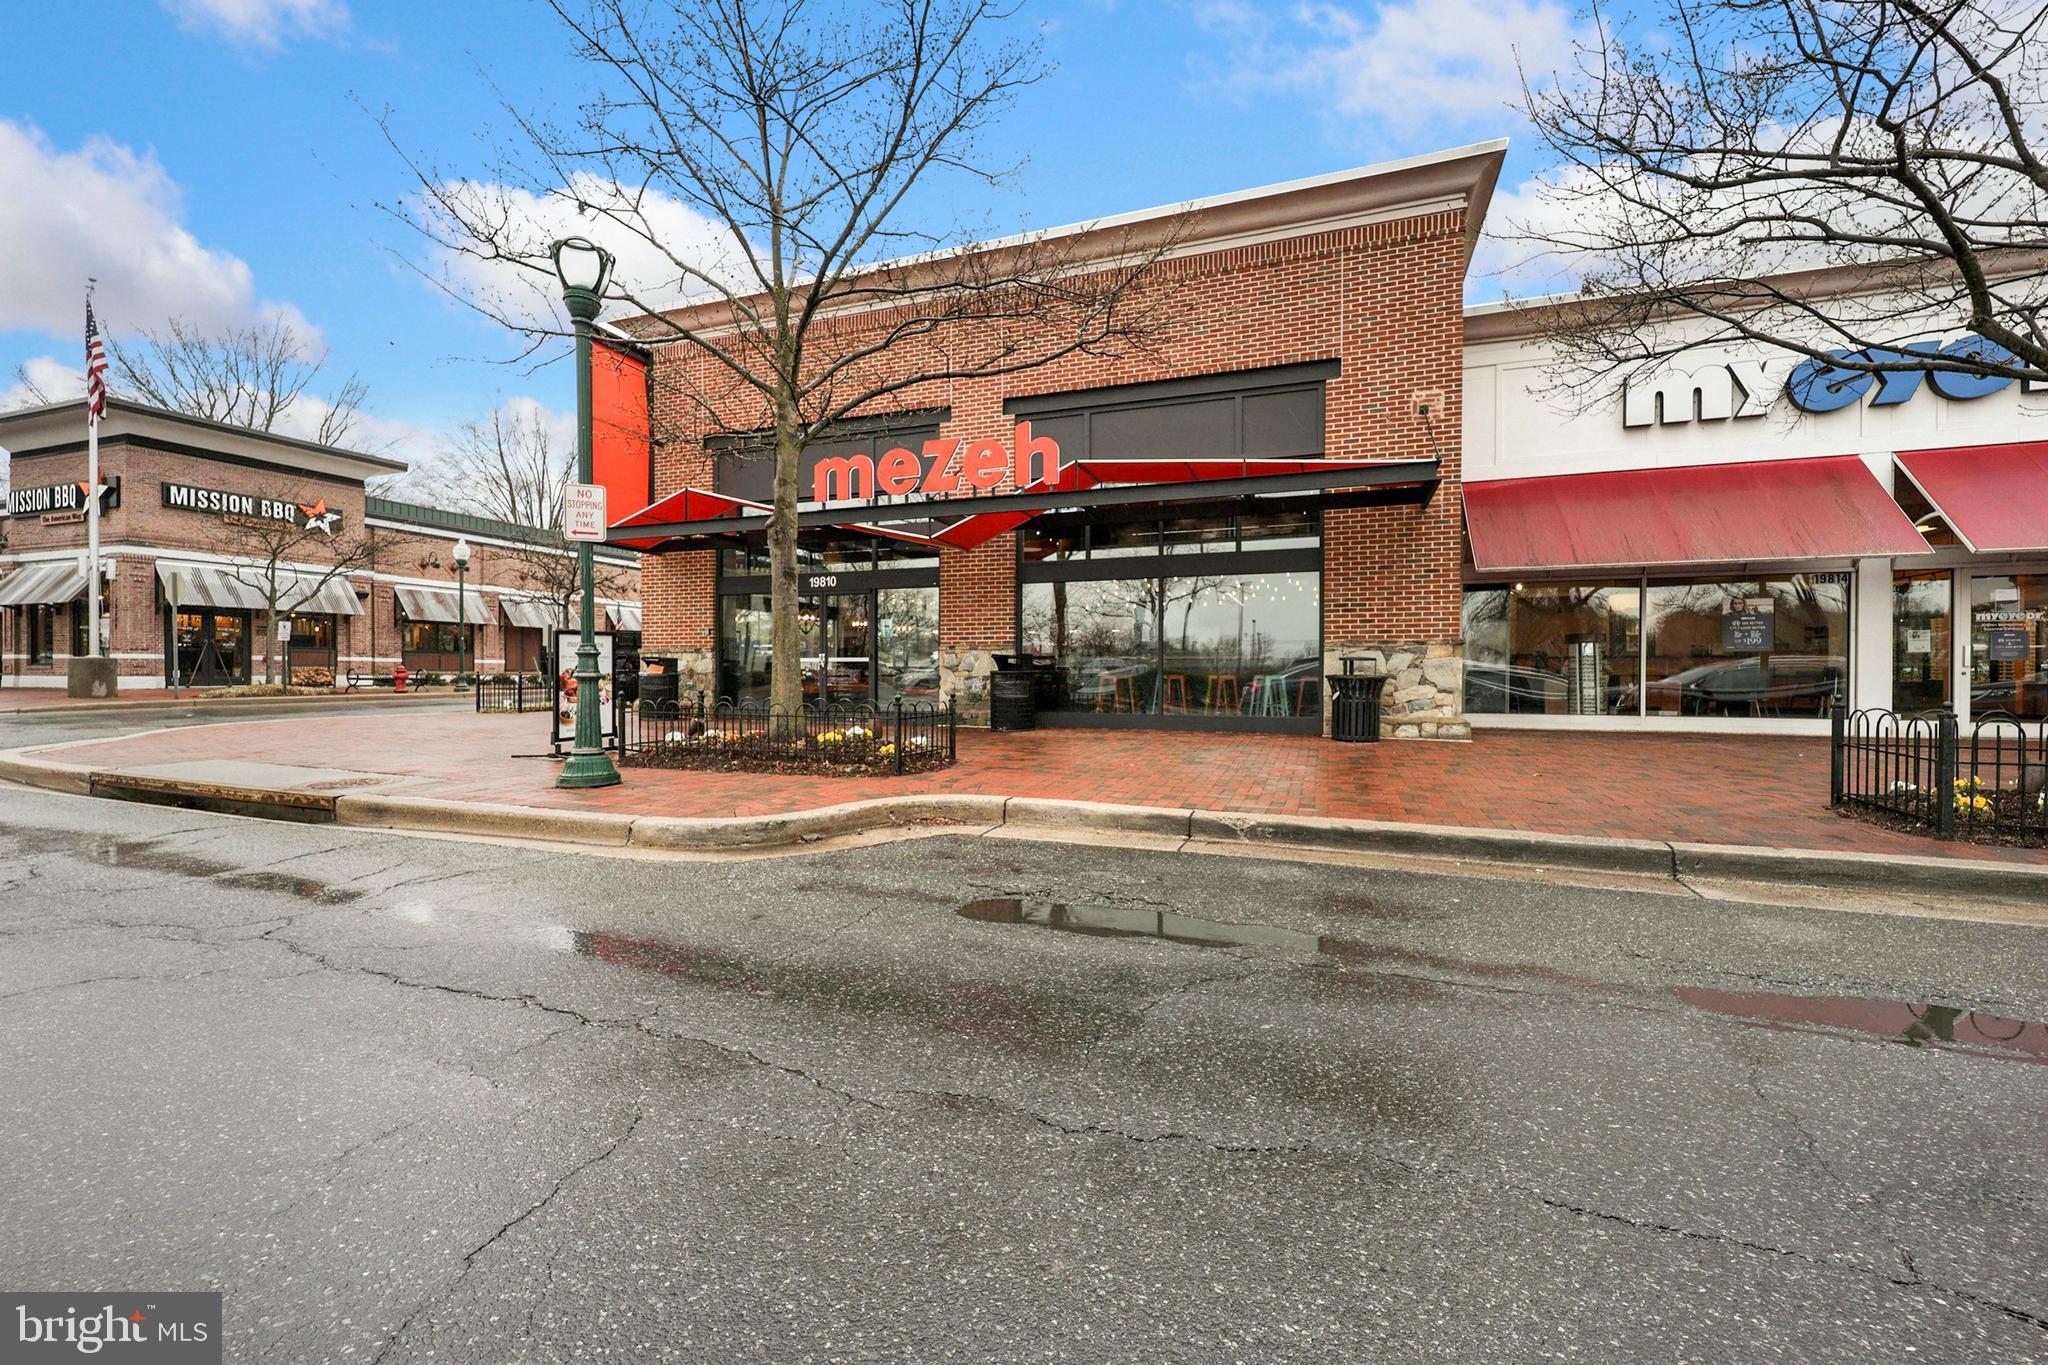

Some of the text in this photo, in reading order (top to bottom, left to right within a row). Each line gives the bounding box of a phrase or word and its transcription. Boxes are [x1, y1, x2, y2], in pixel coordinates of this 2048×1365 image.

[1624, 333, 2048, 430] myeye
[813, 420, 1060, 503] mezeh
[6, 484, 76, 514] MISSION BBQ
[169, 485, 253, 515] MISSION
[261, 499, 295, 523] BBQ
[577, 490, 592, 498] NO
[567, 500, 602, 510] STOPPING
[809, 575, 837, 588] 19810
[1814, 574, 1848, 584] 19814
